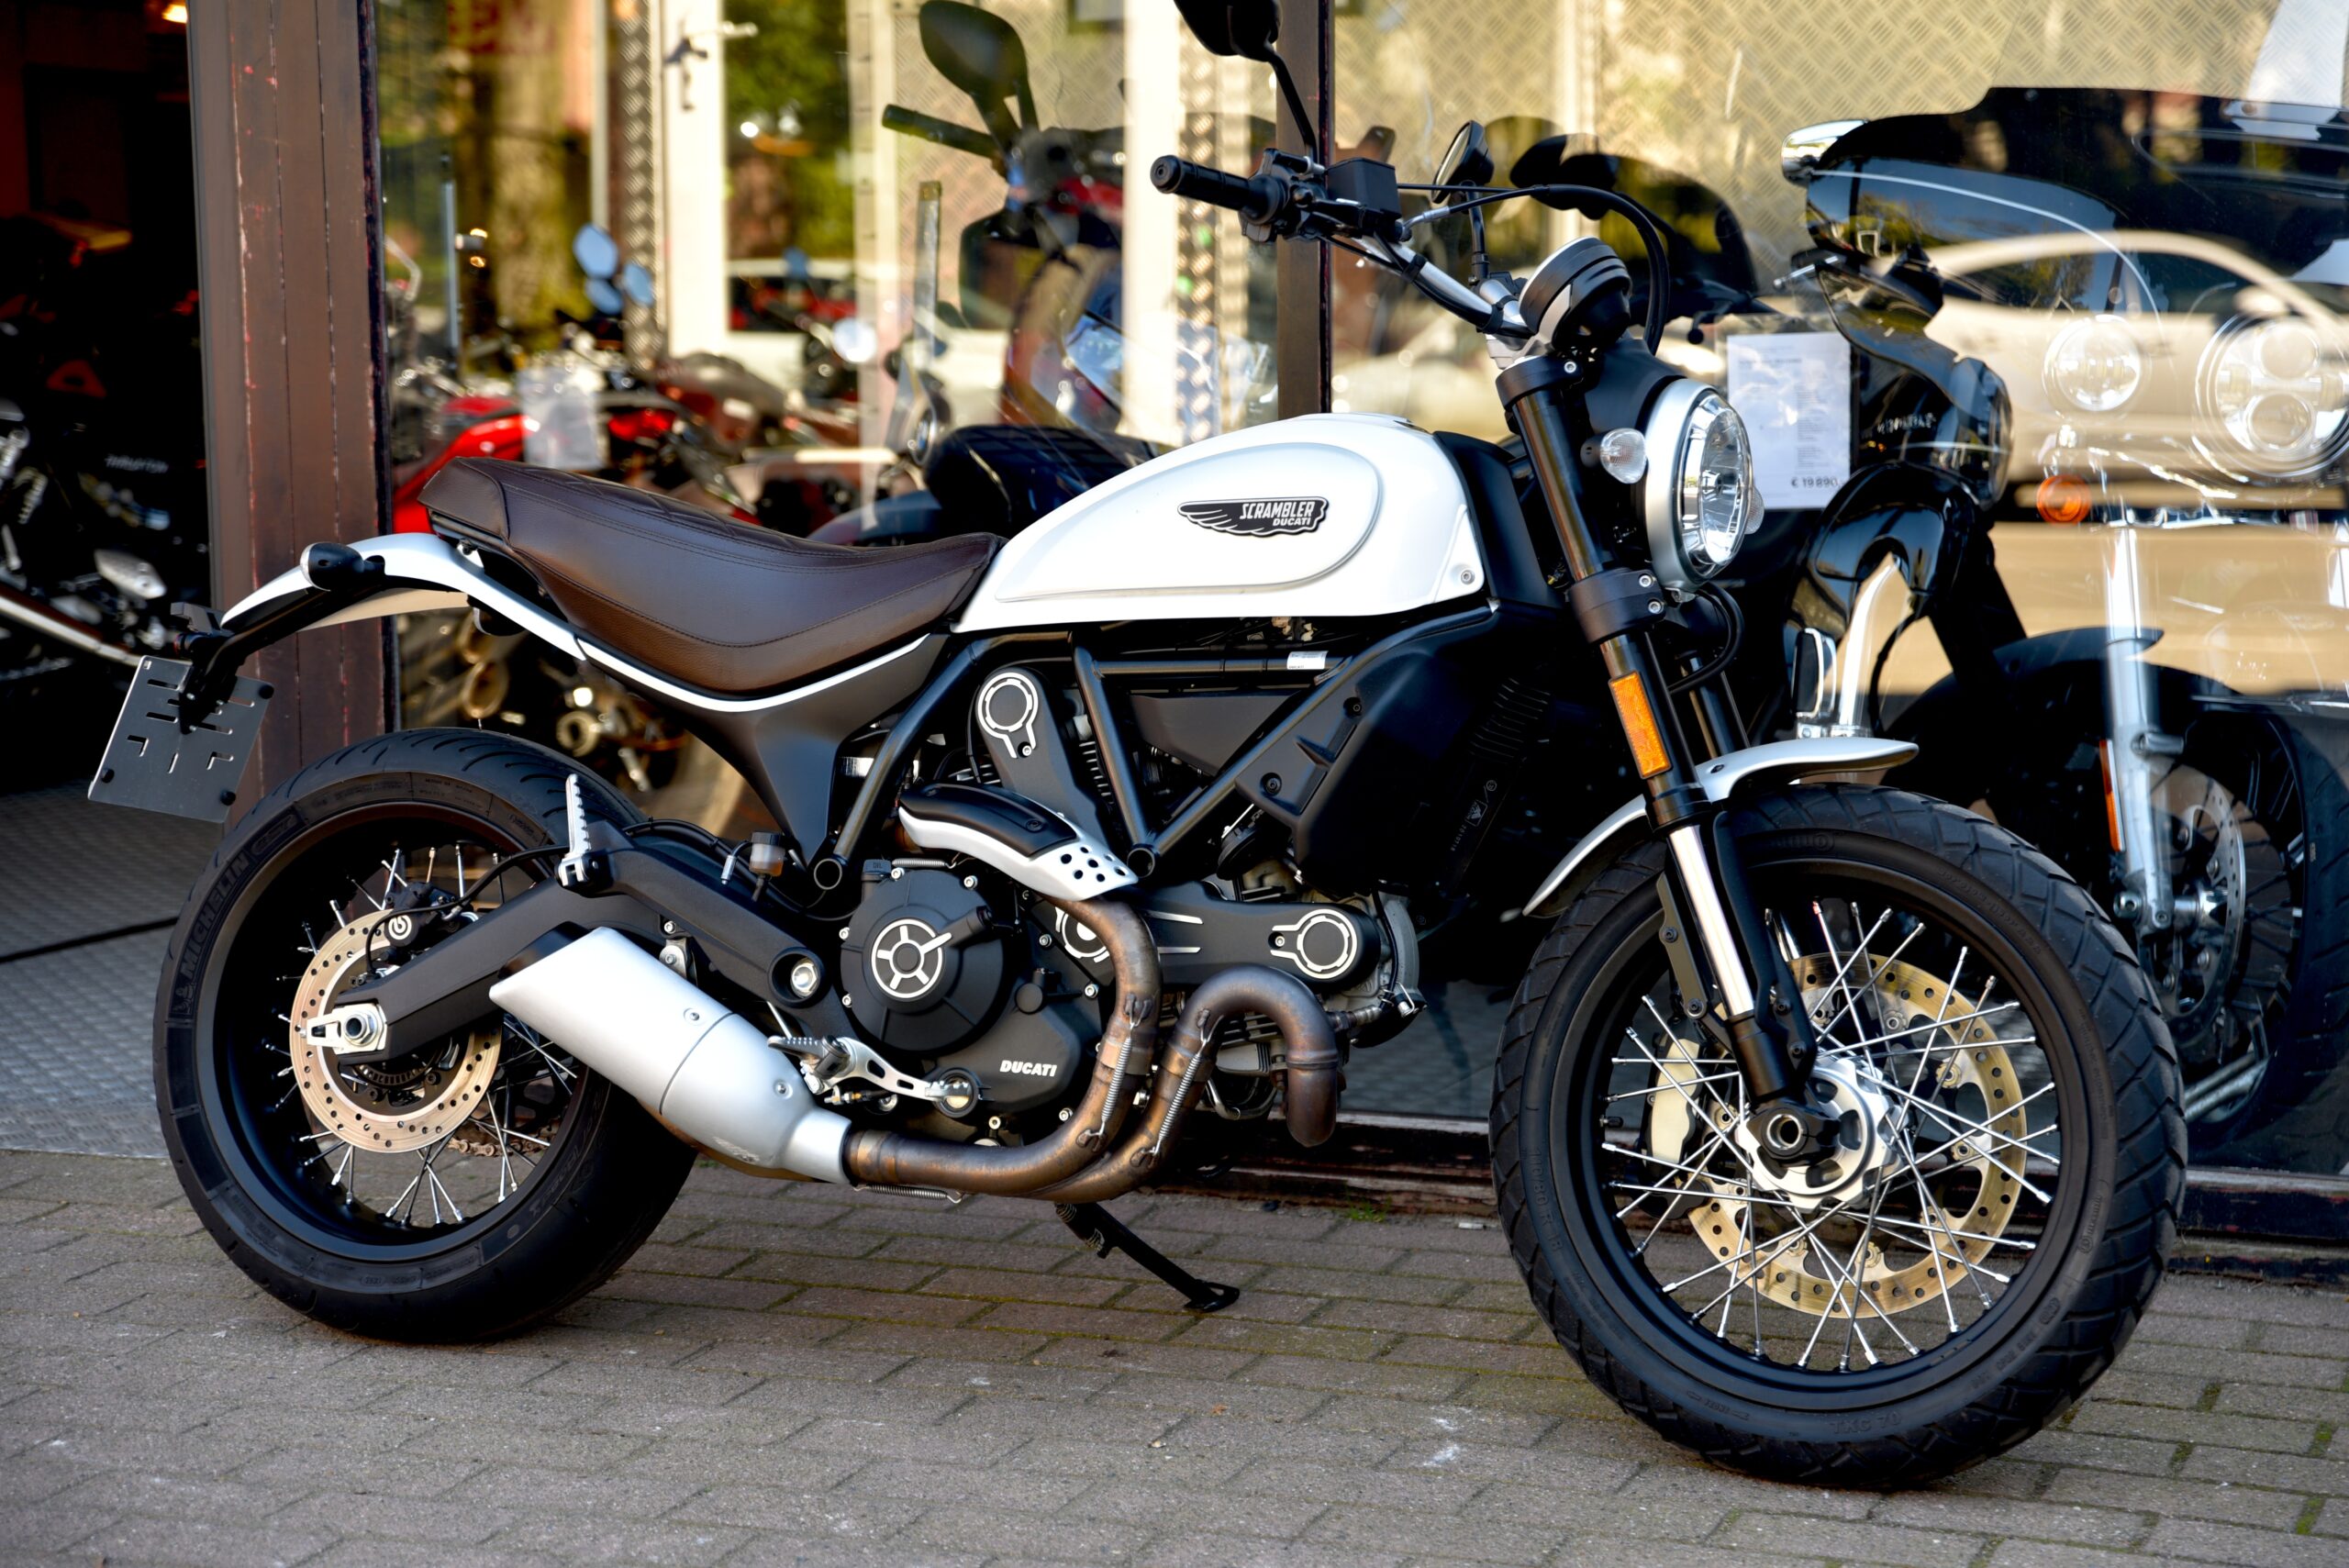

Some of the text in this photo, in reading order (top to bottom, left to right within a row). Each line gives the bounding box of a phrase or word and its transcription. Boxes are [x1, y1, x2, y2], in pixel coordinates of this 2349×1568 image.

[1240, 501, 1315, 518] SCRAMBLER
[1273, 517, 1310, 526] DUCATI
[179, 854, 250, 978] MICHELIN
[999, 1060, 1057, 1077] DUCATI
